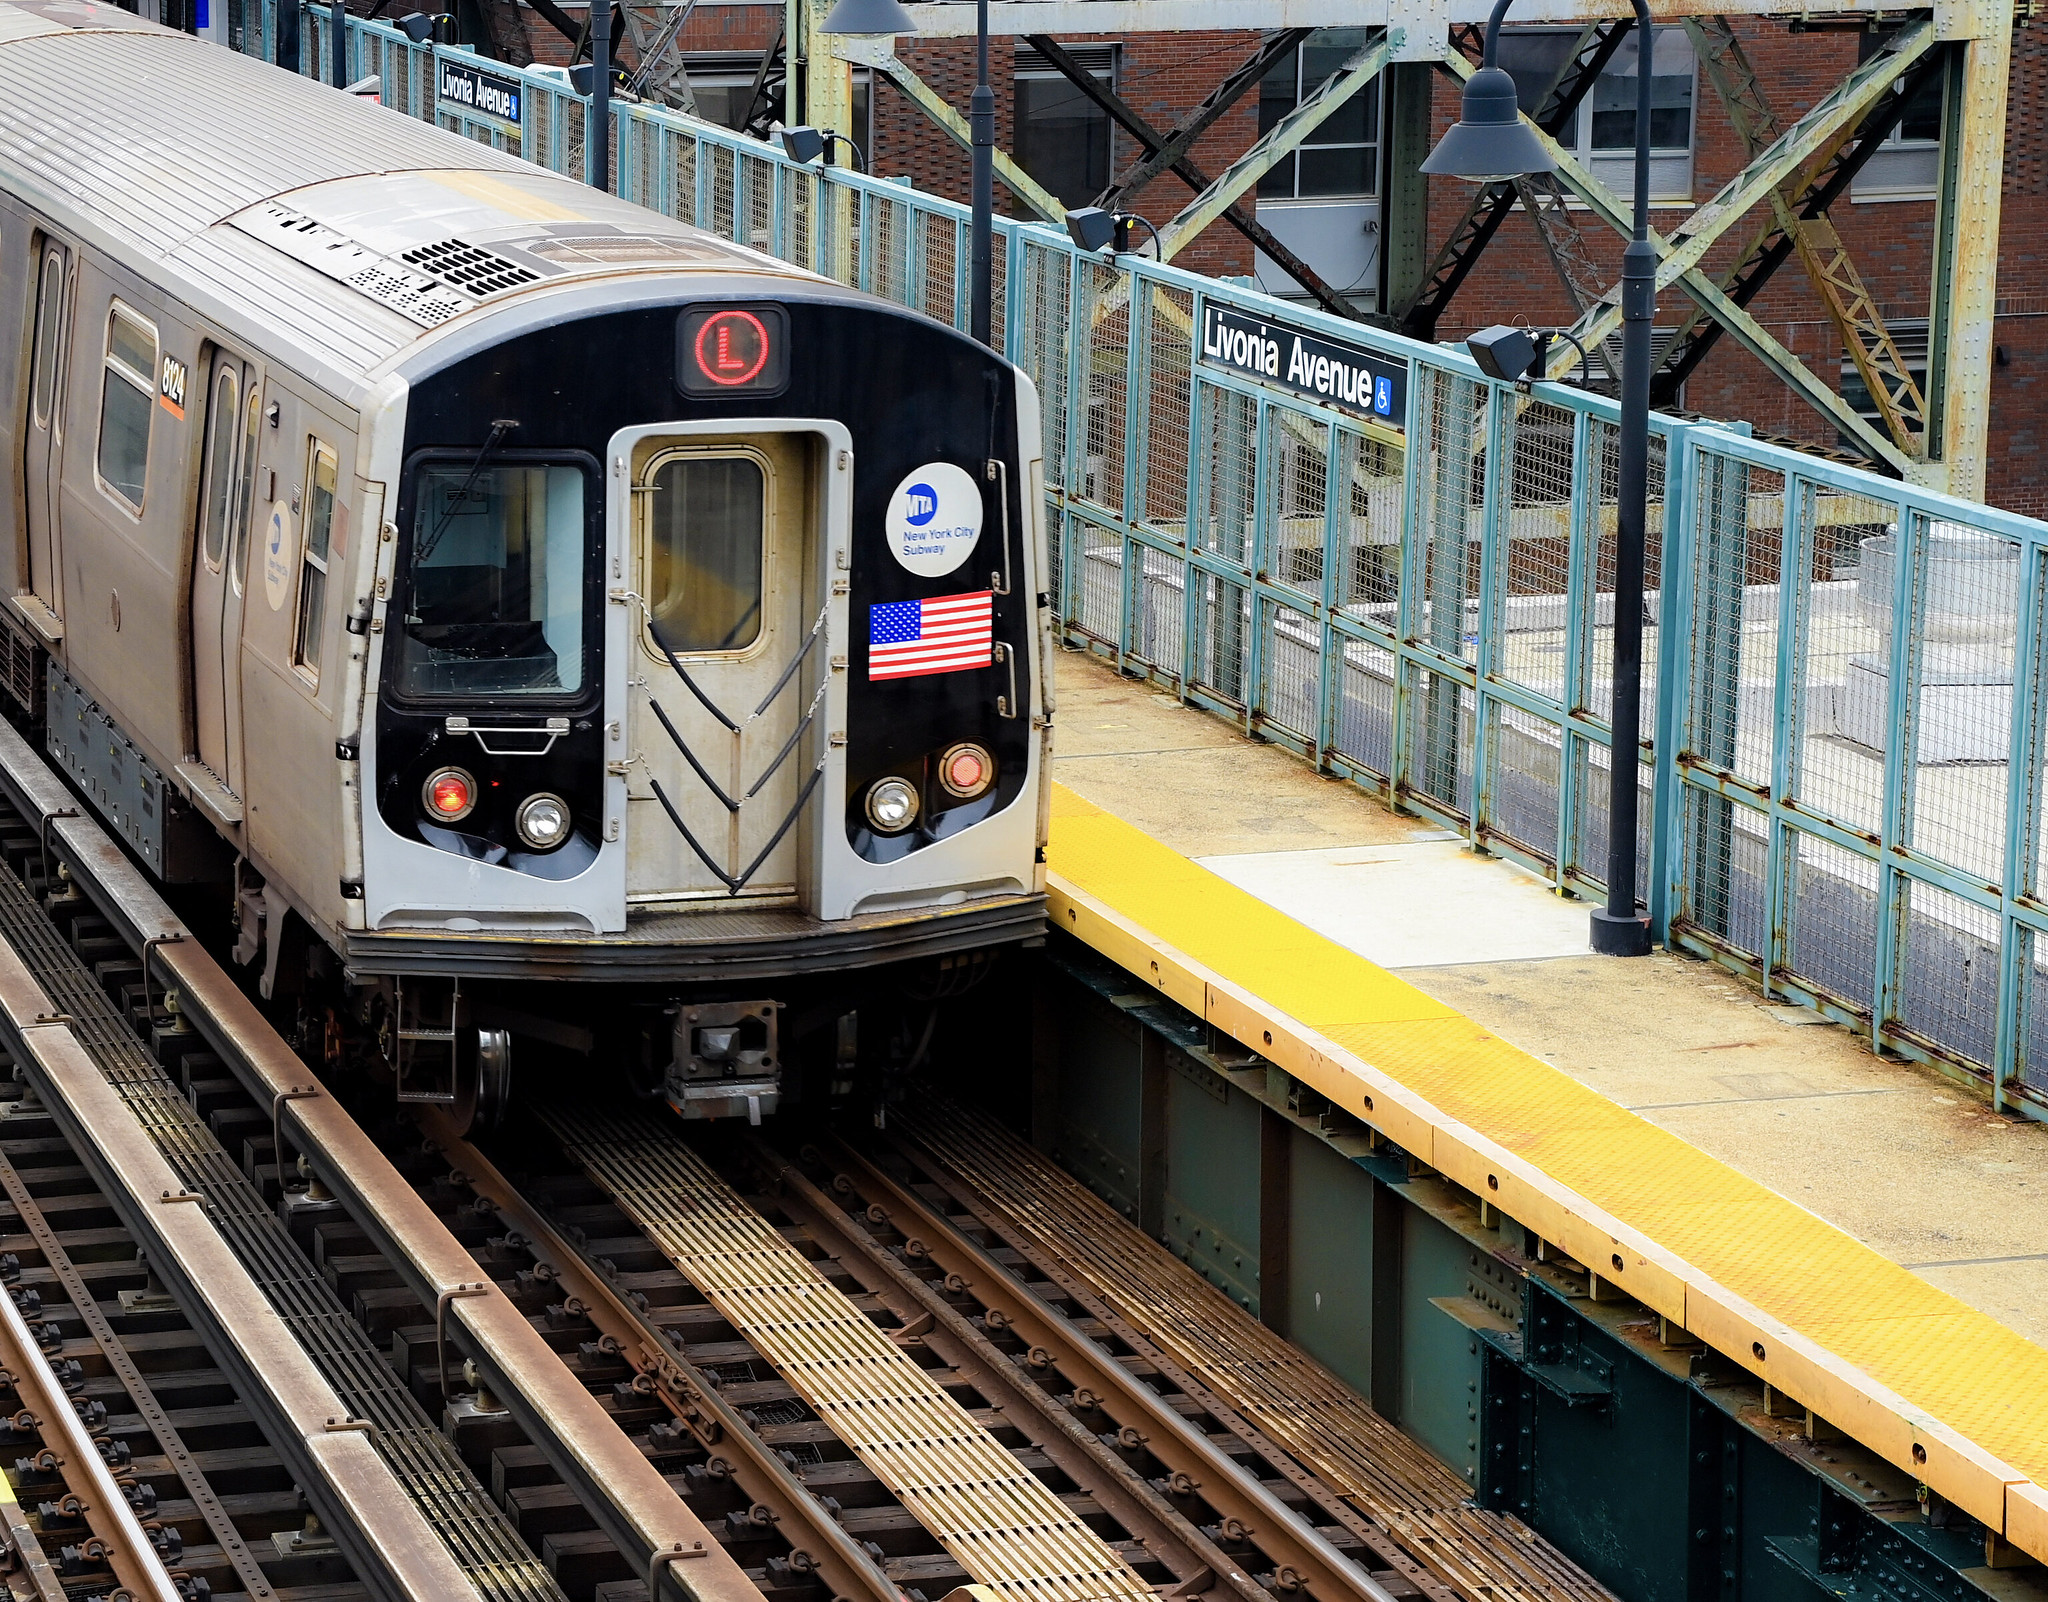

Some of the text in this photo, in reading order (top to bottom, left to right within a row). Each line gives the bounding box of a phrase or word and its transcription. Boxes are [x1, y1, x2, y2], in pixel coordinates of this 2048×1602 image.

[441, 64, 510, 116] Livonia Avenue
[718, 326, 745, 369] L
[1204, 308, 1373, 408] Livonia Avenue
[162, 357, 186, 404] 8124
[905, 493, 933, 518] MTA
[902, 545, 945, 556] Subway
[903, 526, 975, 542] New York City
